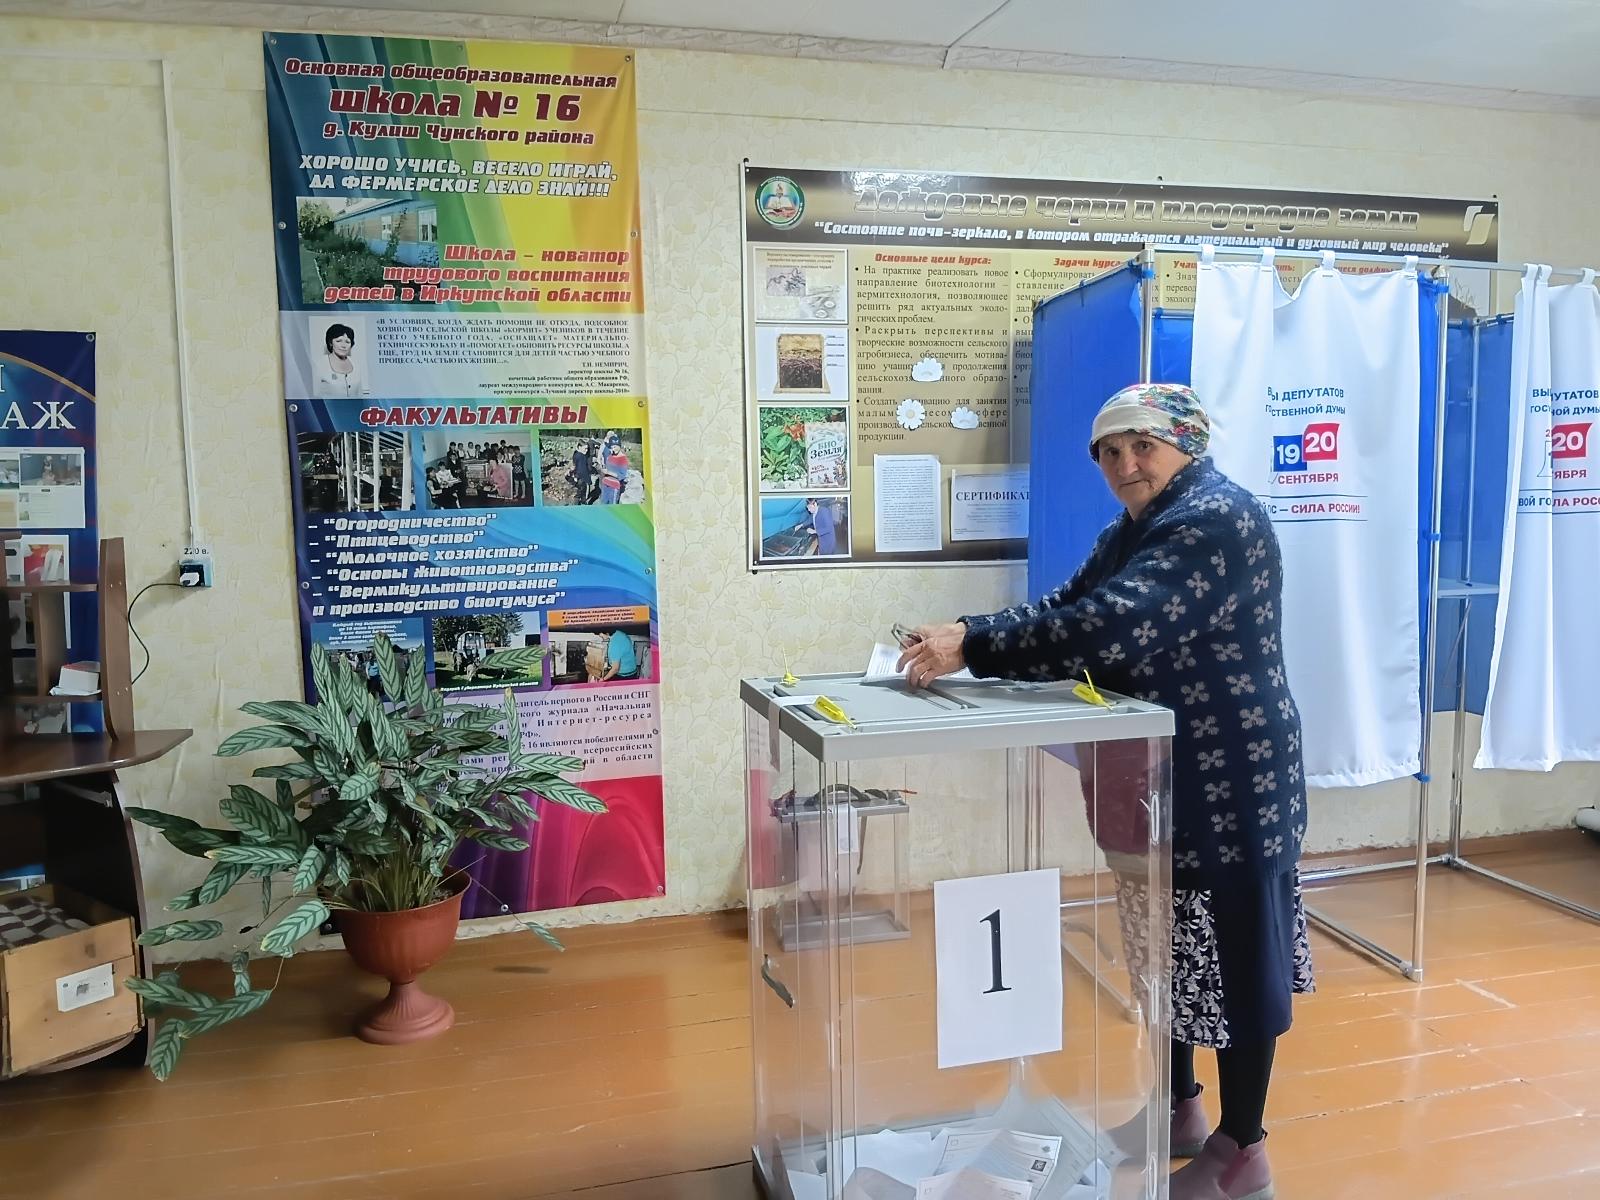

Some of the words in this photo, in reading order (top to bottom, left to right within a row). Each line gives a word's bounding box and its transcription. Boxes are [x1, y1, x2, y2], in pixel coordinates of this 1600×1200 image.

[285, 58, 384, 78] Основная
[390, 64, 617, 88] общеобразовательная
[329, 85, 460, 116] школа
[474, 90, 519, 118] №
[535, 93, 581, 121] 16
[350, 122, 419, 140] Кулиш
[425, 124, 519, 142] Чунского
[524, 128, 594, 145] района
[299, 155, 388, 171] ХОРОШО
[394, 158, 467, 176] УЧИСЬ,
[472, 160, 542, 177] ВЕСЕЛО
[548, 162, 617, 181] ИГРАЙ,
[309, 175, 335, 190] ДА
[342, 175, 480, 193] ФЕРМЕРСКОЕ
[484, 180, 531, 195] ДЕЛО
[537, 179, 609, 197] ЗНАЙ!!!
[1036, 196, 1127, 225] черви
[1133, 201, 1154, 222] и
[1161, 202, 1330, 231] плодородие
[1336, 209, 1419, 232] земли
[1015, 230, 1024, 240] в
[1027, 229, 1090, 244] котором
[1094, 231, 1181, 246] отражается
[1184, 233, 1283, 249] материальный
[1286, 238, 1295, 247] и
[1298, 237, 1359, 251] духовный
[1362, 241, 1387, 252] мир
[444, 245, 516, 262] Школа
[542, 250, 630, 266] новатор
[875, 253, 928, 264] Основные
[930, 254, 956, 266] цели
[959, 254, 992, 268] курса:
[1053, 258, 1089, 268] Задачи
[383, 266, 500, 284] трудового
[507, 268, 630, 283] воспитания
[864, 266, 876, 274] На
[882, 268, 922, 276] практике
[928, 268, 978, 277] реализовать
[857, 280, 918, 288] направление
[926, 280, 996, 289] биотехнологии
[324, 285, 395, 303] детей
[401, 287, 413, 300] в
[421, 285, 540, 304] Иркутской
[546, 287, 631, 303] области
[857, 292, 940, 301] вермитехнология,
[948, 293, 1008, 301] позволяющее
[857, 304, 890, 312] решить
[898, 304, 914, 312] ряд
[921, 304, 972, 312] актуальных
[864, 326, 916, 335] Раскрыть
[924, 328, 994, 337] перспективы
[858, 340, 905, 348] творческие
[857, 351, 912, 359] агробизнеса,
[920, 350, 968, 358] обеспечить
[864, 397, 898, 405] Создать
[1282, 388, 1344, 402] ДЕПУТАТОВ
[360, 405, 587, 426] ФАКУЛЬТАТИВЫ
[1326, 405, 1346, 414] ДУМЫ
[818, 440, 837, 450] БИО
[1305, 432, 1336, 453] 20
[1552, 431, 1584, 452] 20
[810, 446, 842, 460] Земля
[1276, 444, 1300, 464] 19
[1278, 473, 1339, 485] СЕНТЯБРЯ
[1291, 504, 1326, 514] СИЛА
[1328, 503, 1360, 514] РОССИИ!
[313, 607, 324, 616] и
[330, 598, 460, 618] производство
[550, 697, 586, 707] первого
[594, 694, 622, 702] России
[631, 691, 650, 699] СНГ
[548, 706, 589, 716] журнала
[596, 702, 652, 712] «Начальная
[538, 714, 652, 727] Интернет-ресурса
[540, 740, 583, 748] являются
[584, 734, 645, 744] победителями
[584, 743, 653, 754] всероссийских
[616, 753, 654, 762] области
[980, 908, 1012, 994] 1
